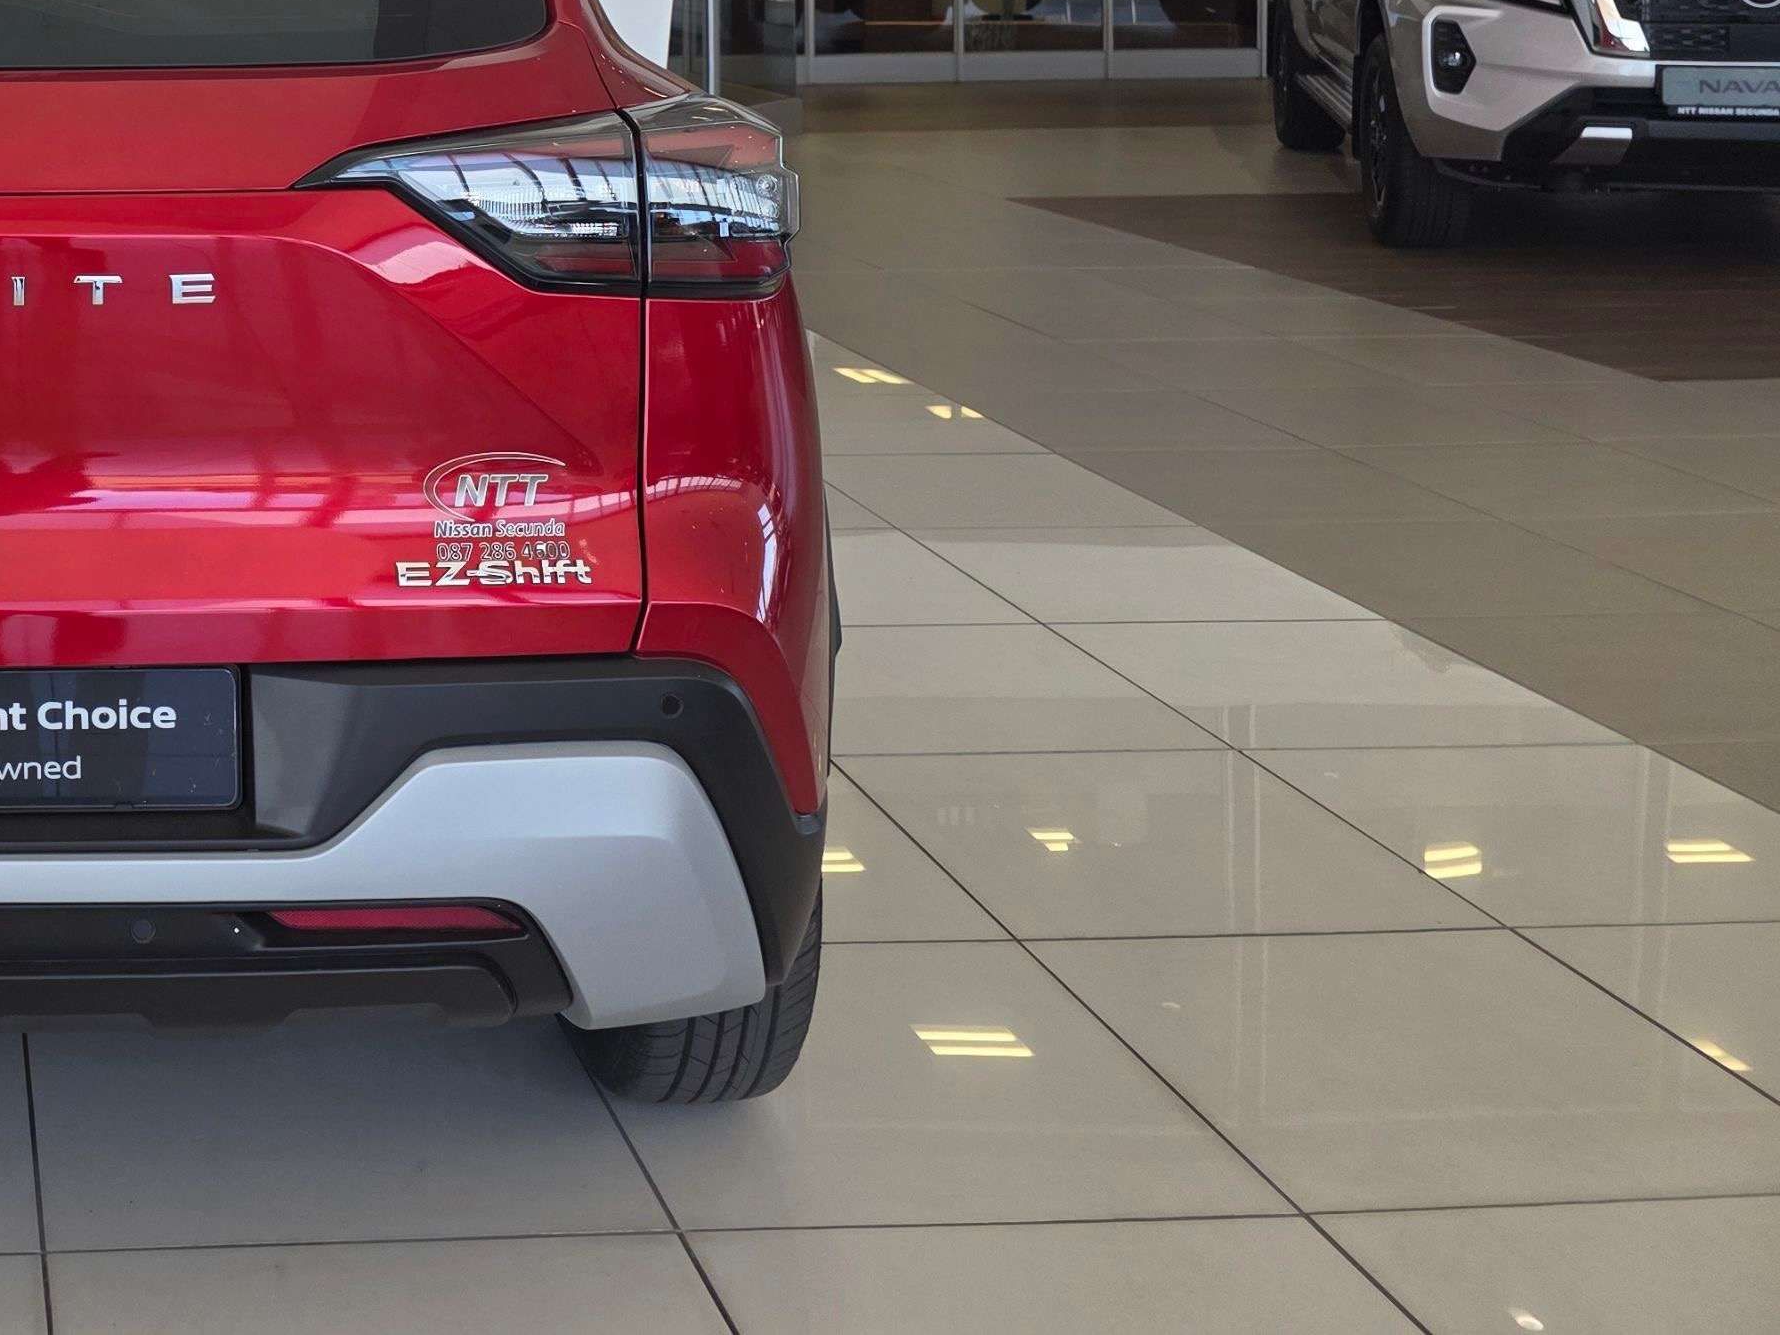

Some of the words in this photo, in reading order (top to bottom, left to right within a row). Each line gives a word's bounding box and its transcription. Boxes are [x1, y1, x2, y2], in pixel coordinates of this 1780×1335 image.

[453, 473, 549, 508] NTT
[434, 519, 493, 538] Nissan
[495, 518, 566, 537] Secunda
[436, 543, 473, 561] 087
[481, 542, 516, 560] 286
[37, 698, 177, 731] Choice
